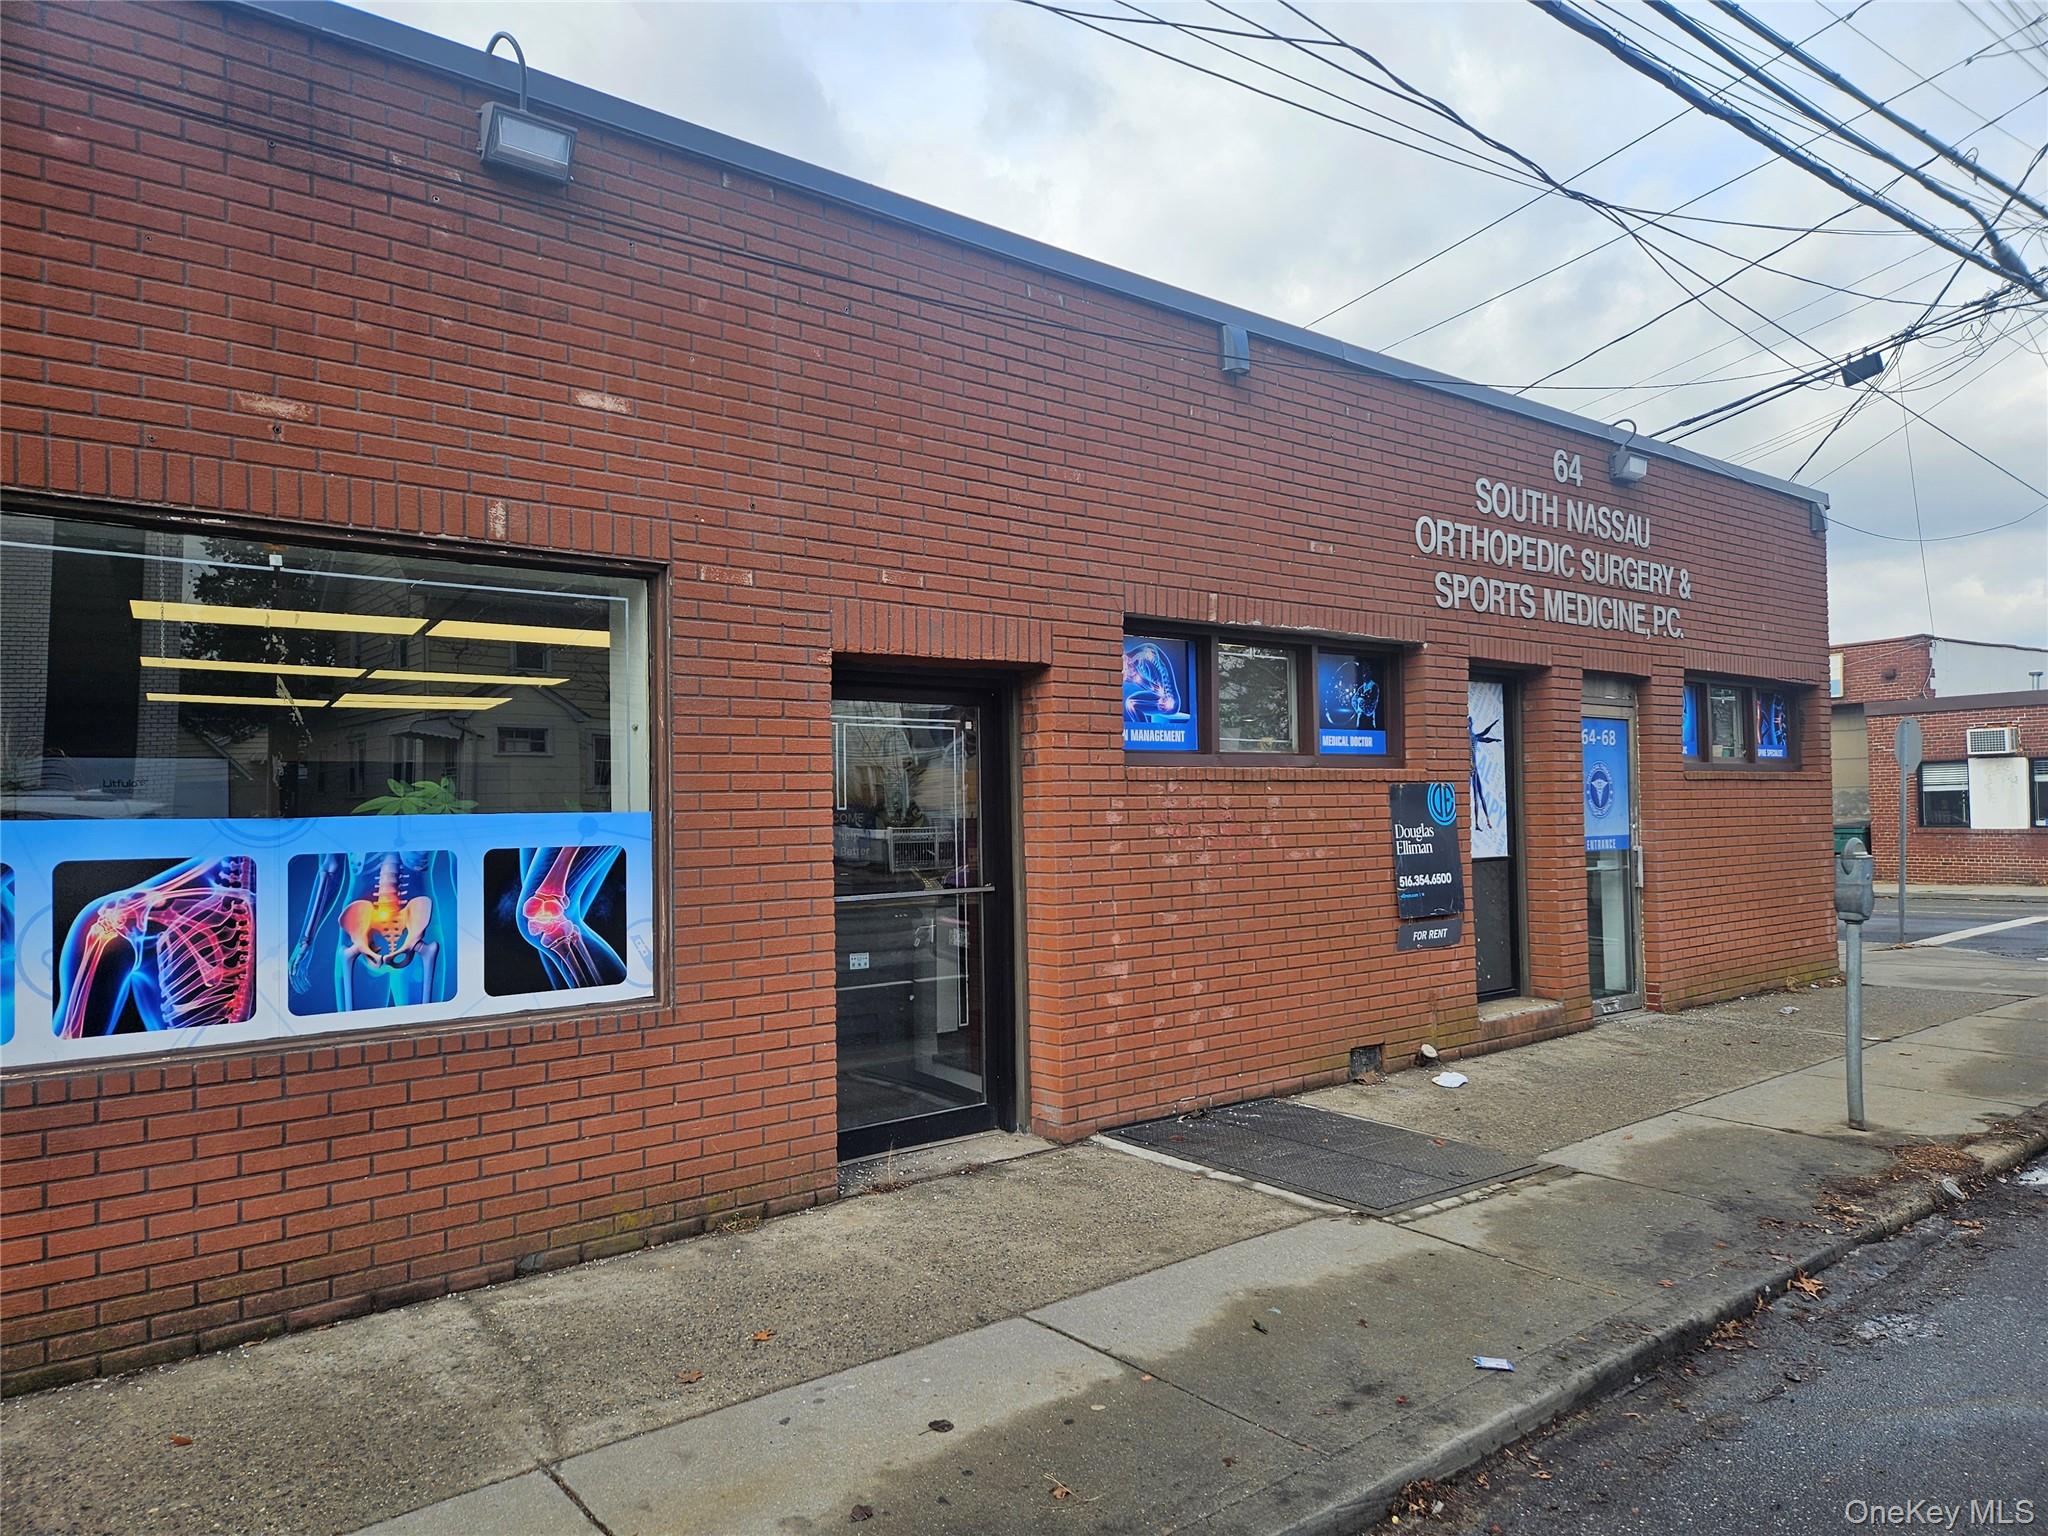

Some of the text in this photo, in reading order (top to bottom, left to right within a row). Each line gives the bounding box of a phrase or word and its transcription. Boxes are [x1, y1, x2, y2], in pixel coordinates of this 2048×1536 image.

[1553, 448, 1583, 487] 64
[1475, 477, 1651, 549] SOUTH NASSAU
[1415, 515, 1691, 599] ORTHOPEDIC SURGERY &
[1434, 571, 1536, 619] SPORTS
[1130, 729, 1185, 742] MANAGEMENT
[1322, 735, 1373, 747] MEDICAL DOCTOR
[1581, 728, 1616, 746] 64-68
[1395, 824, 1434, 841] Douglas
[1396, 840, 1433, 855] Elliman
[1586, 838, 1616, 849] ENTRANCE
[1400, 873, 1452, 888] 516.354.6500
[1413, 928, 1448, 941] FOR RENT
